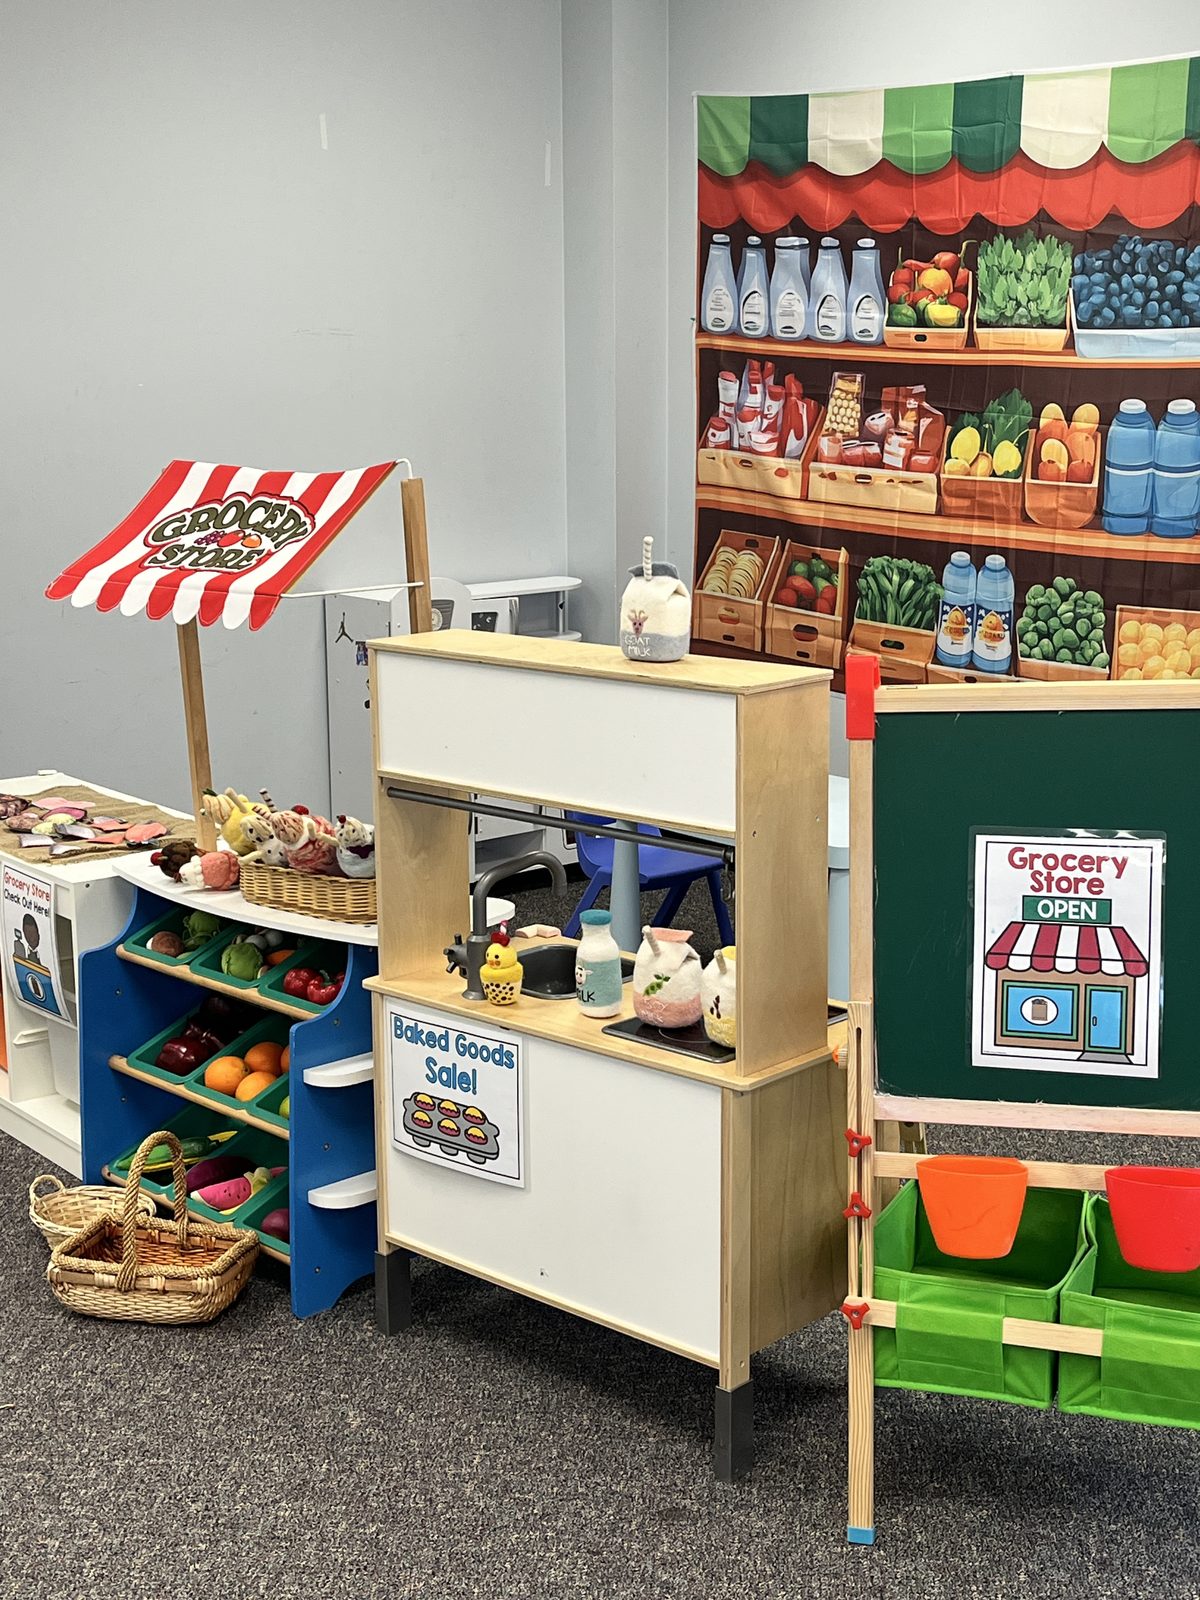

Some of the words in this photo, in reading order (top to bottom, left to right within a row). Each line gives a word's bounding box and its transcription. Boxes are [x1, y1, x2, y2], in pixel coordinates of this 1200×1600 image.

[151, 499, 309, 549] GROCERY
[148, 543, 265, 570] STORE
[624, 634, 650, 646] GOAT
[627, 645, 651, 657] MILK
[1007, 846, 1129, 879] Grocery
[4, 871, 31, 896] Grocery
[31, 883, 50, 901] Store
[1029, 869, 1105, 896] Store
[3, 888, 21, 905] Check
[22, 896, 33, 909] Out
[33, 901, 49, 917] Here!
[1036, 899, 1098, 920] OPEN
[393, 1016, 450, 1052] Baked
[454, 1033, 515, 1069] Goods
[425, 1056, 478, 1095] Sale!
